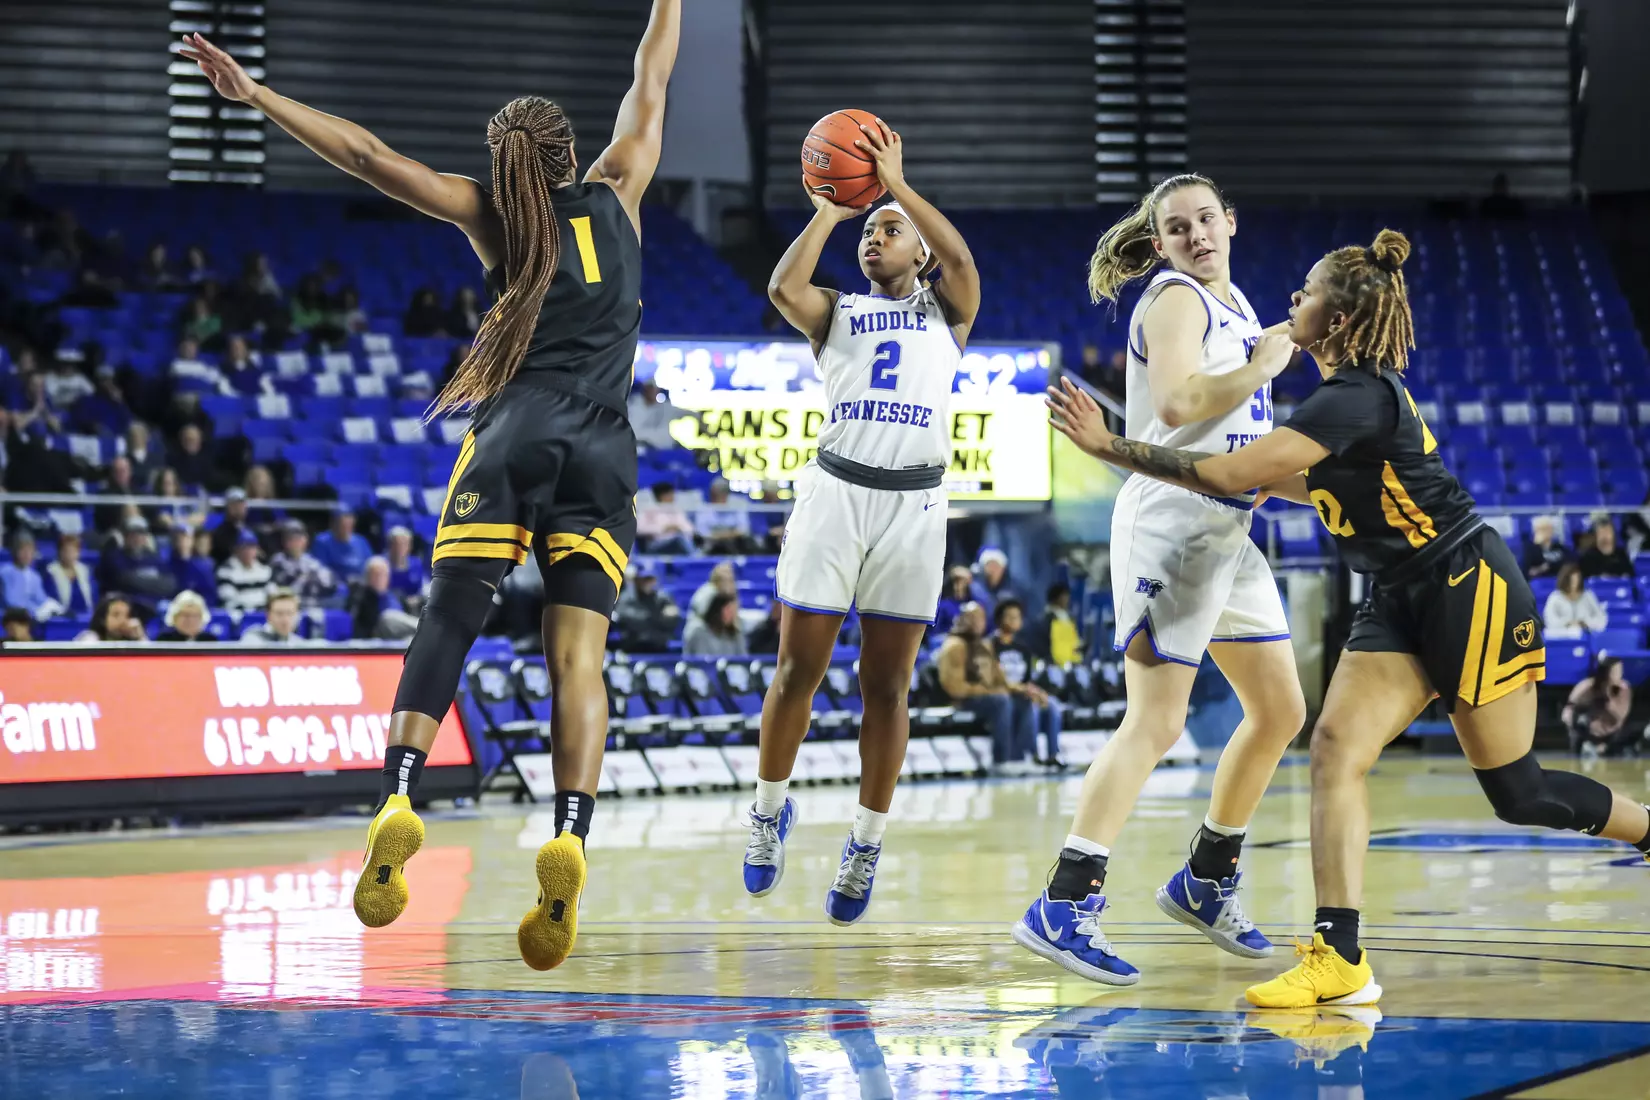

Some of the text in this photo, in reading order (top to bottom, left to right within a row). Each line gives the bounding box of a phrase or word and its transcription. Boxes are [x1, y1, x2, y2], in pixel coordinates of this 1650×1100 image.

[569, 216, 602, 283] 1
[850, 311, 927, 336] MIDDLE
[869, 340, 901, 391] 2
[831, 400, 933, 428] TENNESSEE
[0, 691, 97, 754] arm
